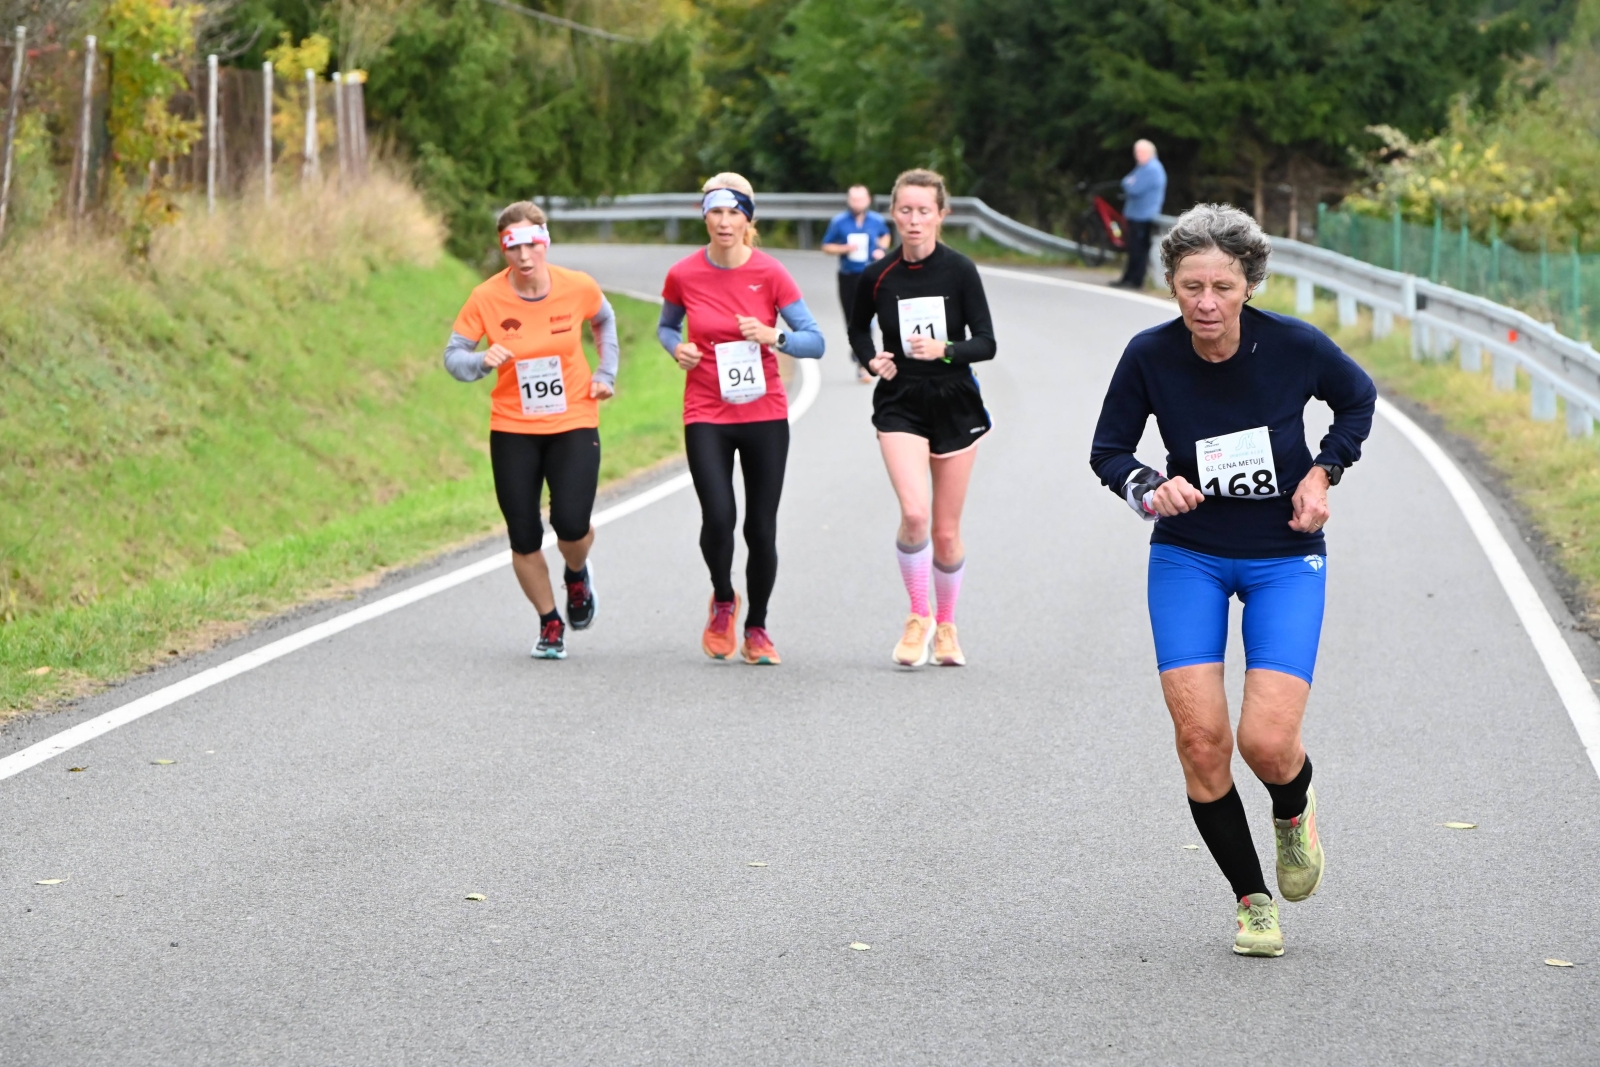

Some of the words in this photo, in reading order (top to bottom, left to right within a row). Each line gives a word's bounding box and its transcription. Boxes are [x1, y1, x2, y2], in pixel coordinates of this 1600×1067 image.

[728, 366, 756, 387] 94
[521, 378, 563, 399] 196
[1204, 452, 1223, 462] CUP
[1217, 461, 1237, 471] CENA
[1238, 457, 1265, 467] METUJE
[1204, 469, 1276, 497] 168
